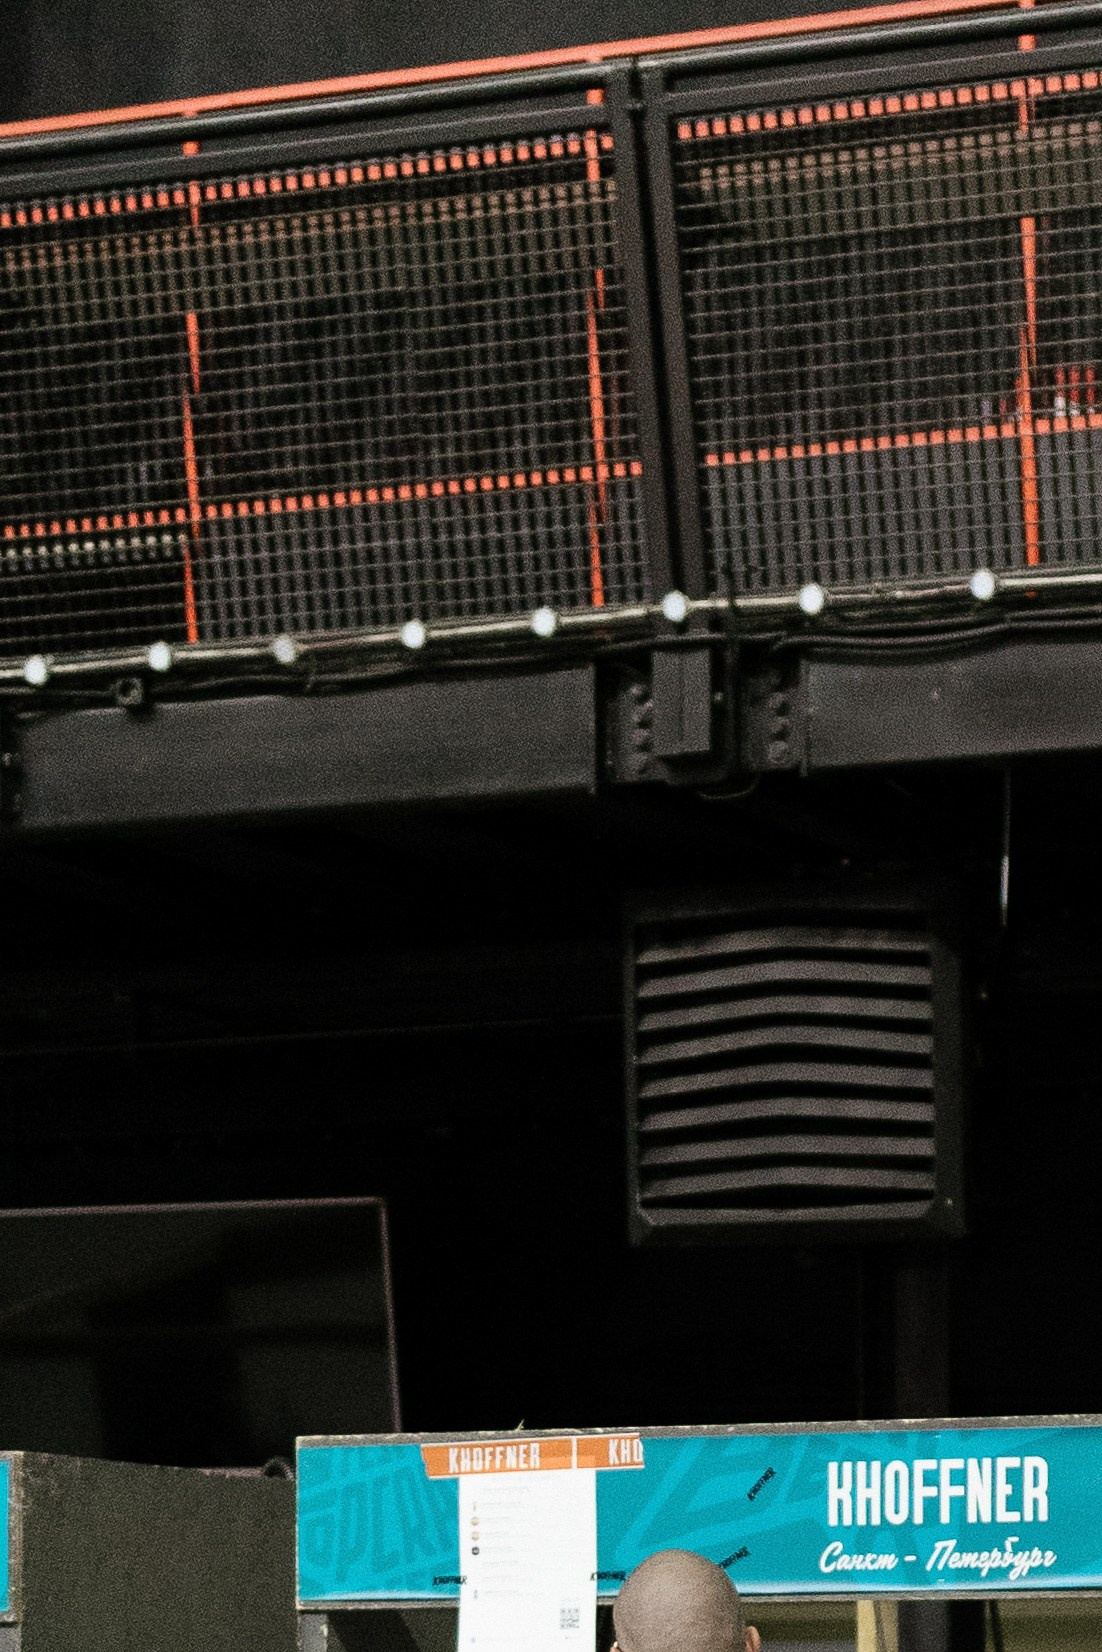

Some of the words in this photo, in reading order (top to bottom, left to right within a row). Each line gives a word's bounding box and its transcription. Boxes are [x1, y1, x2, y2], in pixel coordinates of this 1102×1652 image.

[448, 1442, 541, 1474] KHOFFNER
[827, 1455, 1050, 1527] KHOFFNER
[818, 1540, 899, 1574] Санкт
[925, 1535, 1057, 1581] Петербург
